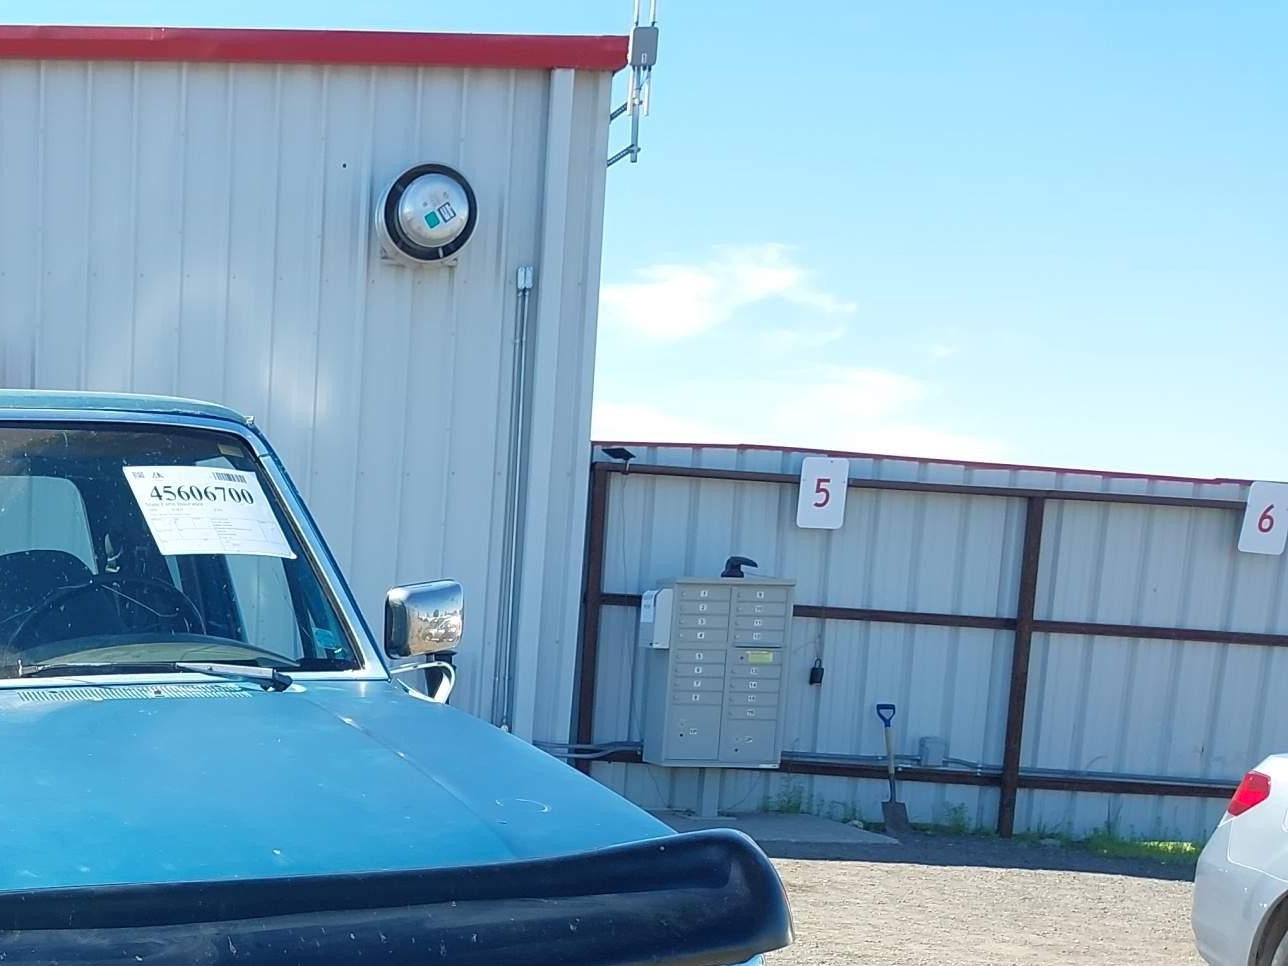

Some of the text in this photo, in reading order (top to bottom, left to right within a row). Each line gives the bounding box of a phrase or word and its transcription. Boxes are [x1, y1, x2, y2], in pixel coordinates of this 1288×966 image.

[150, 485, 254, 505] 45606700
[813, 478, 831, 508] 5
[1258, 503, 1274, 534] 6
